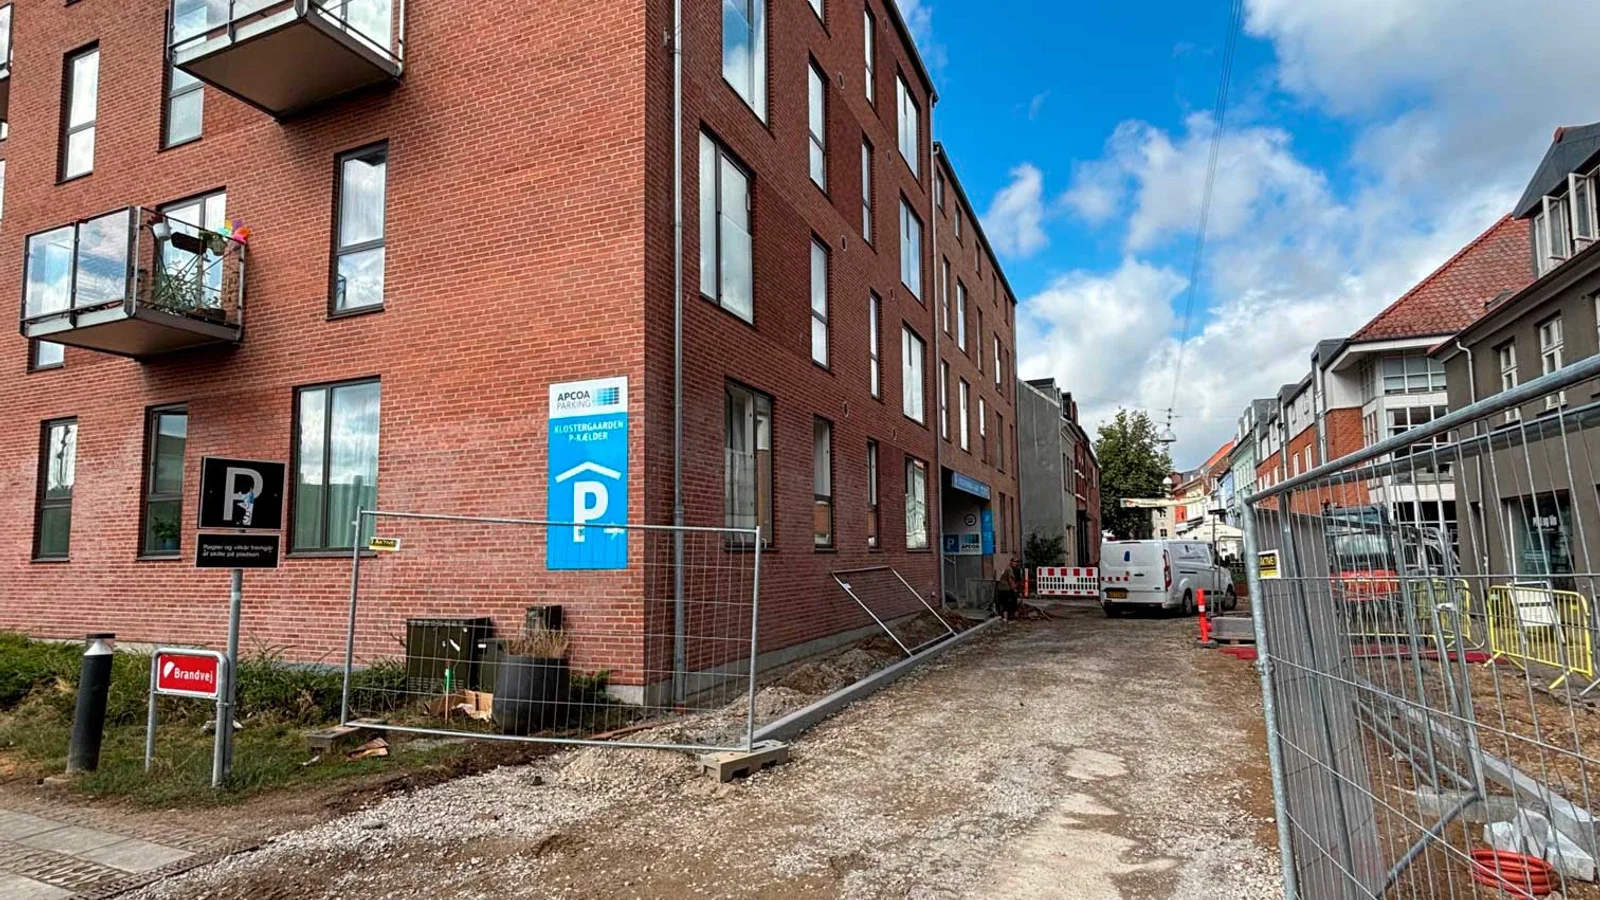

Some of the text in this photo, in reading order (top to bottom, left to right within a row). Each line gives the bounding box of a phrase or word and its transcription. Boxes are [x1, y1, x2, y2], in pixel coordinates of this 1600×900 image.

[558, 390, 591, 402] APCOA
[557, 400, 591, 411] PARKING
[554, 420, 624, 434] KLOSTERGAARDEN
[568, 431, 608, 442] P-KÆLDER
[573, 480, 609, 543] P
[174, 667, 213, 684] Brandvej
